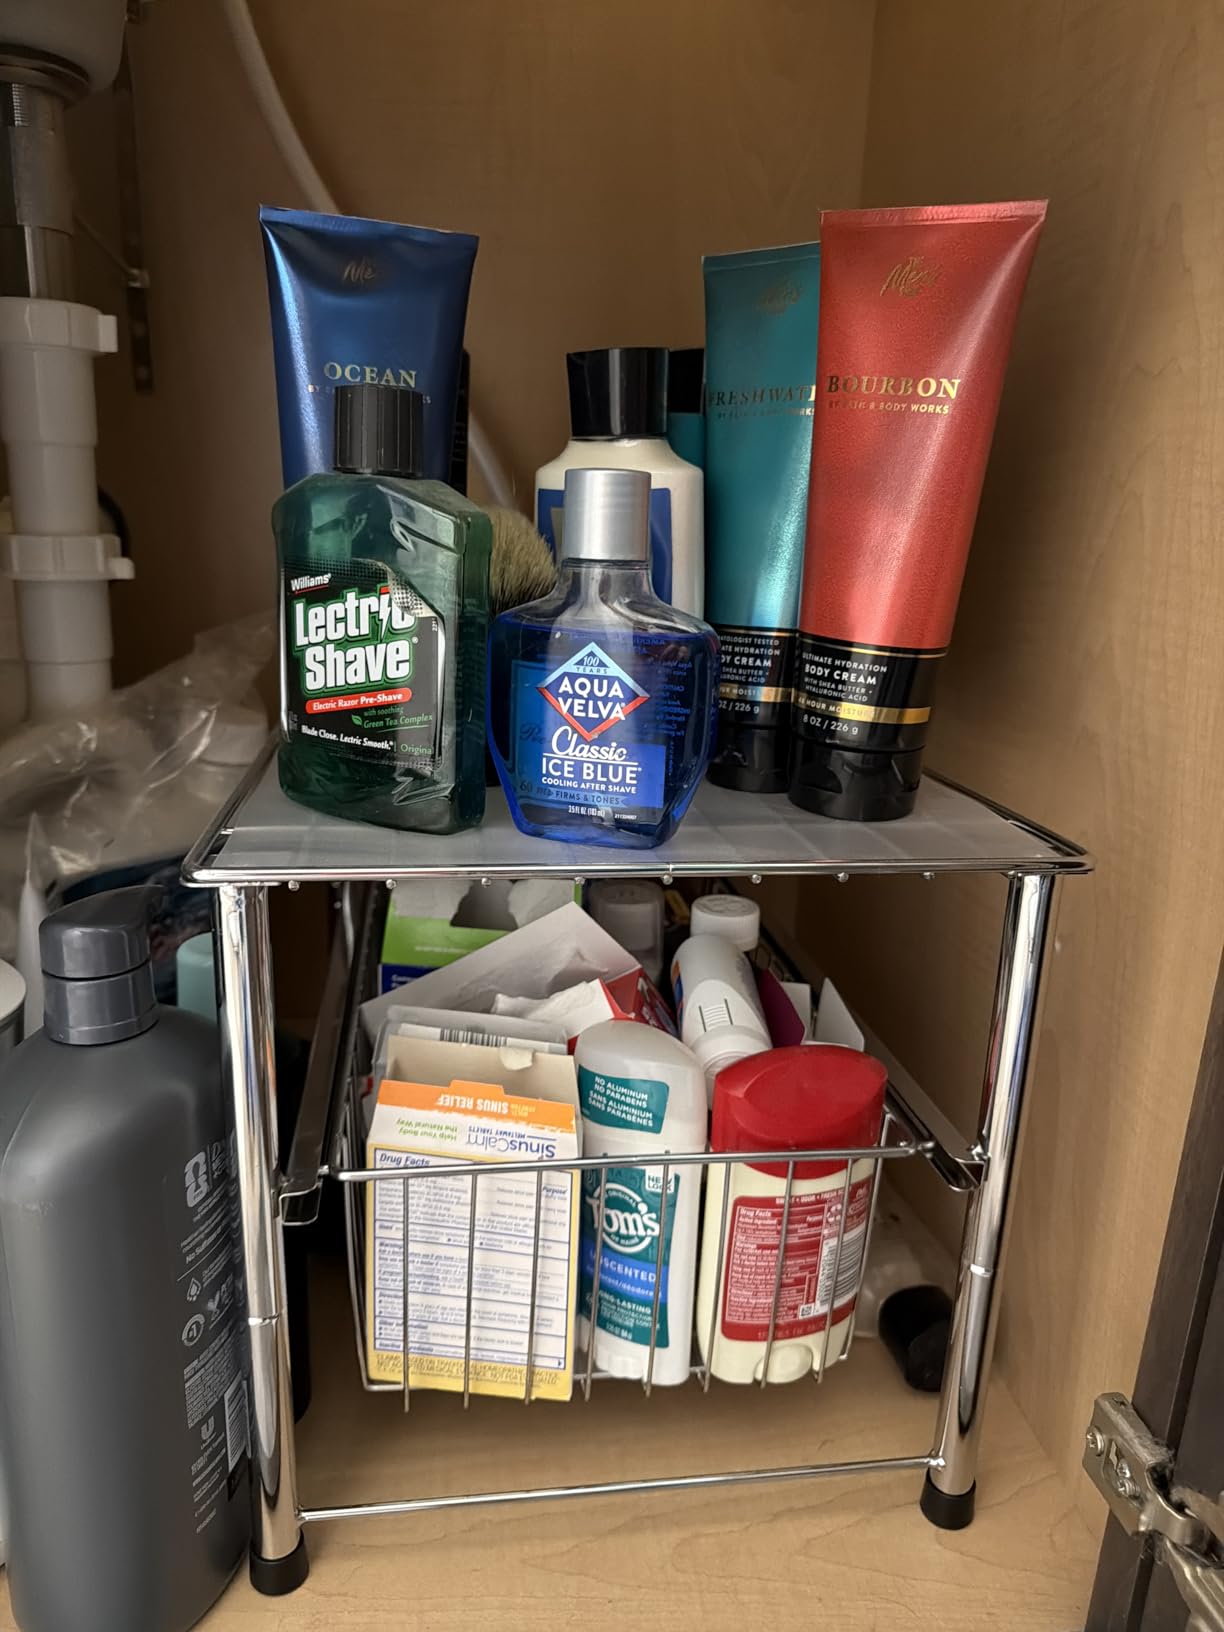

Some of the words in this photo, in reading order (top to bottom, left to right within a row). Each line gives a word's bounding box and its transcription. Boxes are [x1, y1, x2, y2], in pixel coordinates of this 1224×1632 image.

[323, 362, 417, 388] OCEAN
[826, 375, 960, 399] BOURBON
[880, 402, 907, 412] BODY
[911, 403, 949, 414] WORKS
[291, 573, 331, 591] Williams
[295, 586, 415, 646] Lectric
[754, 638, 780, 646] TESTED
[734, 646, 780, 656] HYDRATION
[305, 639, 410, 691] Shave
[583, 655, 600, 667] 100
[734, 656, 772, 667] CREAM
[802, 652, 832, 665] ULTIMATE
[834, 659, 887, 673] HYDRATION
[804, 663, 830, 677] BODY
[833, 670, 876, 685] CREAM
[558, 676, 624, 698] AQUA
[804, 677, 817, 685] WITH
[819, 680, 836, 689] SHEA
[837, 684, 866, 693] BUTTER
[805, 684, 846, 699] HYALURONIC
[848, 694, 868, 702] ACID
[313, 701, 336, 711] Electric
[338, 699, 358, 708] Razor
[360, 693, 403, 705] Pre-Shave
[557, 697, 626, 720] VELVA
[735, 702, 751, 712] 226
[753, 706, 760, 714] g
[806, 698, 826, 710] HOUR
[377, 706, 404, 716] soothing
[364, 719, 383, 729] Green
[385, 718, 398, 726] Tea
[399, 713, 433, 725] Complex
[803, 714, 808, 723] 8
[810, 716, 822, 727] OZ
[830, 721, 849, 732] 226
[852, 727, 859, 735] g
[301, 725, 318, 737] Blade
[319, 729, 338, 741] Close.
[340, 733, 362, 745] Lectric
[551, 725, 627, 761] Classic
[542, 757, 574, 778] ICE
[583, 763, 638, 784] BLUE
[541, 777, 578, 788] COOLING
[580, 782, 606, 792] AFTER
[608, 785, 636, 794] SHAVE
[555, 790, 580, 801] FIRMS
[591, 796, 620, 805] TONES
[594, 1083, 605, 1093] NO
[606, 1089, 647, 1108] PARABENS
[595, 1076, 605, 1086] NO
[607, 1081, 648, 1101] ALUMINUM
[435, 1094, 474, 1110] RELIEF
[476, 1098, 509, 1115] SINUS
[588, 1097, 605, 1111] SANS
[589, 1090, 607, 1105] SANS
[608, 1100, 653, 1119] ALUMINIUM
[396, 1118, 413, 1127] Way
[415, 1121, 443, 1131] Natural
[469, 1126, 492, 1134] TABLETS
[399, 1127, 419, 1136] Body
[420, 1130, 437, 1139] Your
[439, 1132, 457, 1141] Help
[495, 1130, 526, 1139] MELTAWAY
[466, 1134, 556, 1160] SinusCalm
[379, 1153, 402, 1166] Drug
[404, 1155, 431, 1167] Facts
[542, 1186, 567, 1195] Purpose
[585, 1195, 660, 1237] Tom's
